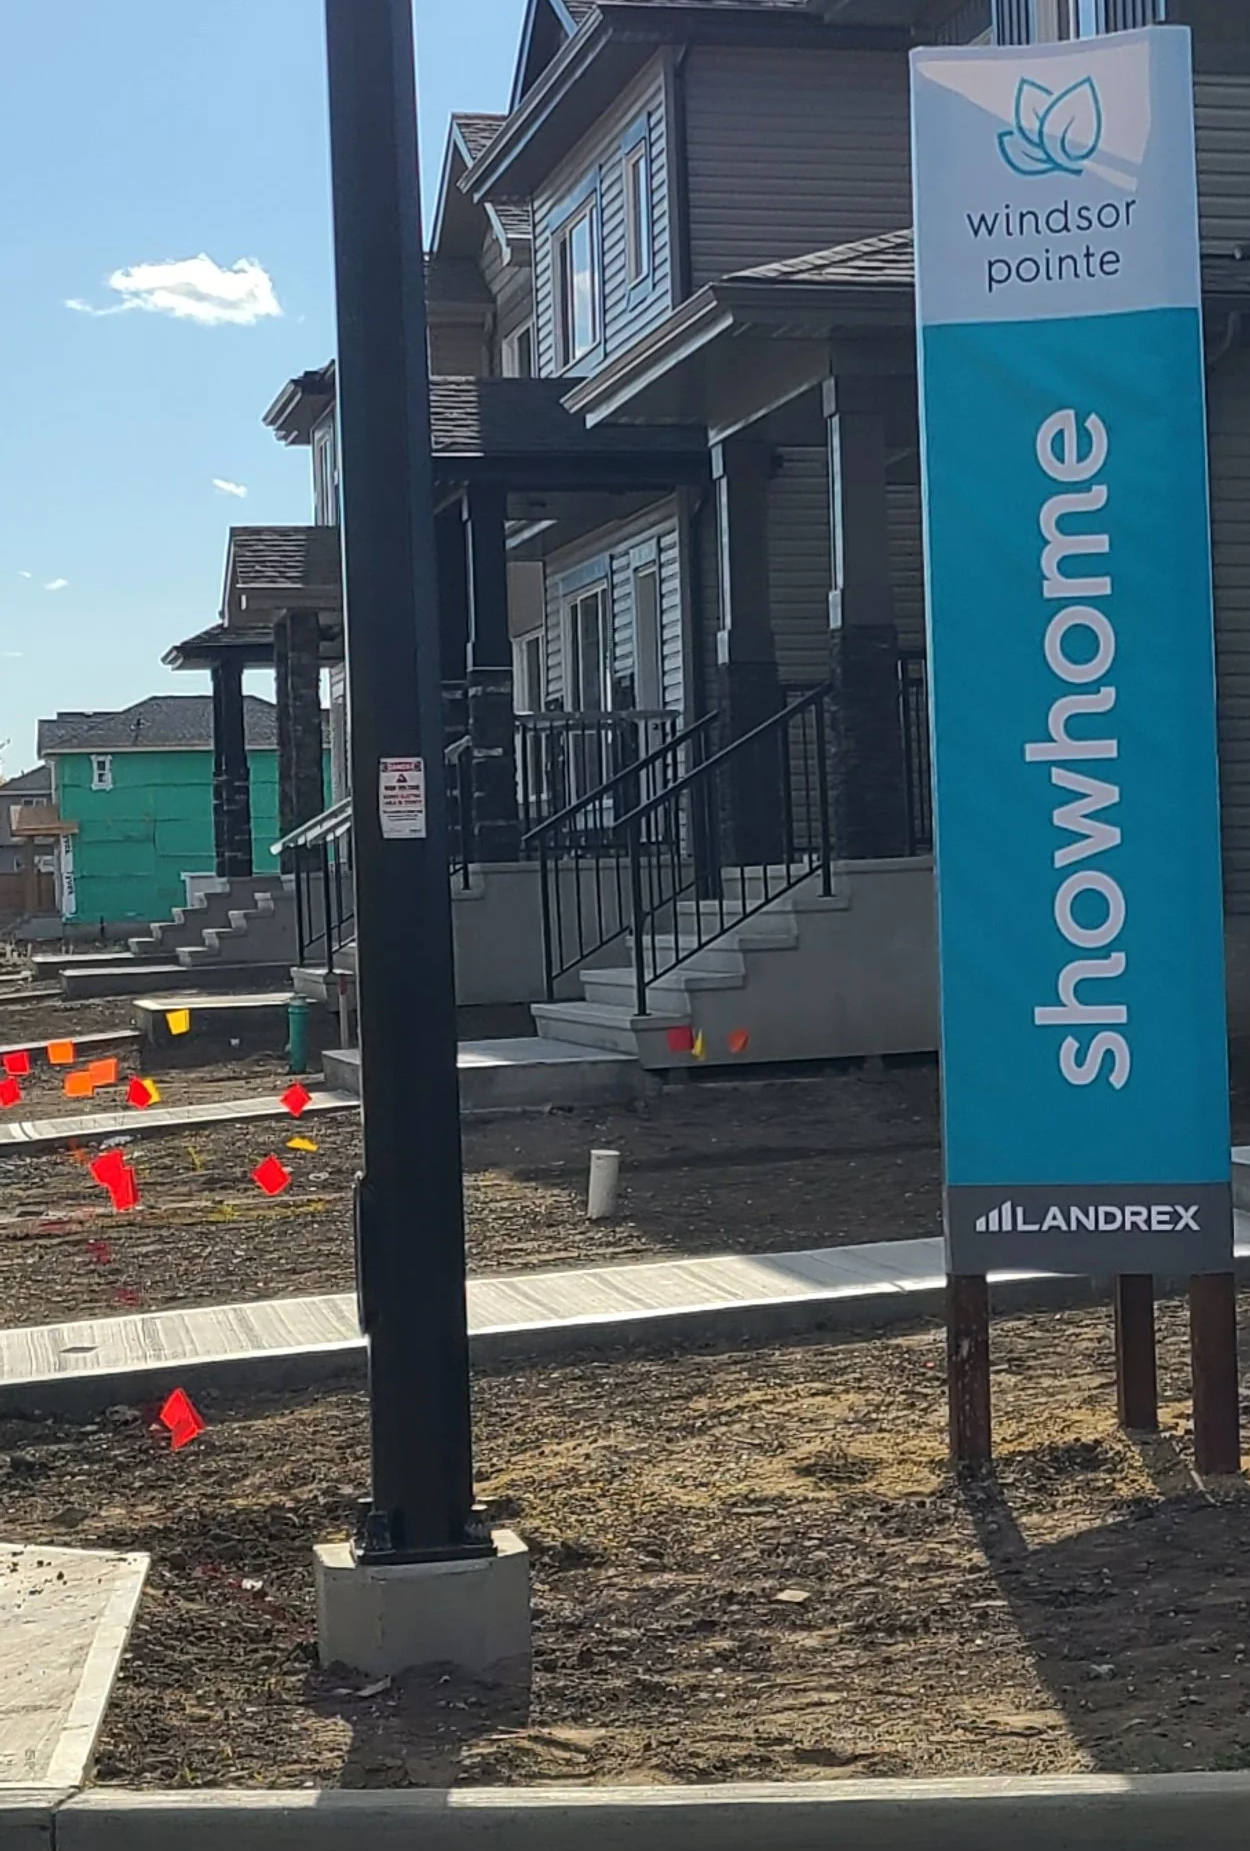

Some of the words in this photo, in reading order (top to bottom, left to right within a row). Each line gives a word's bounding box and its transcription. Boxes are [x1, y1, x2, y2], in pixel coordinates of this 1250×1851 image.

[966, 199, 1137, 238] windsor
[987, 244, 1121, 294] pointe
[1023, 406, 1132, 1092] showhome
[1016, 1204, 1201, 1232] LANDREX
